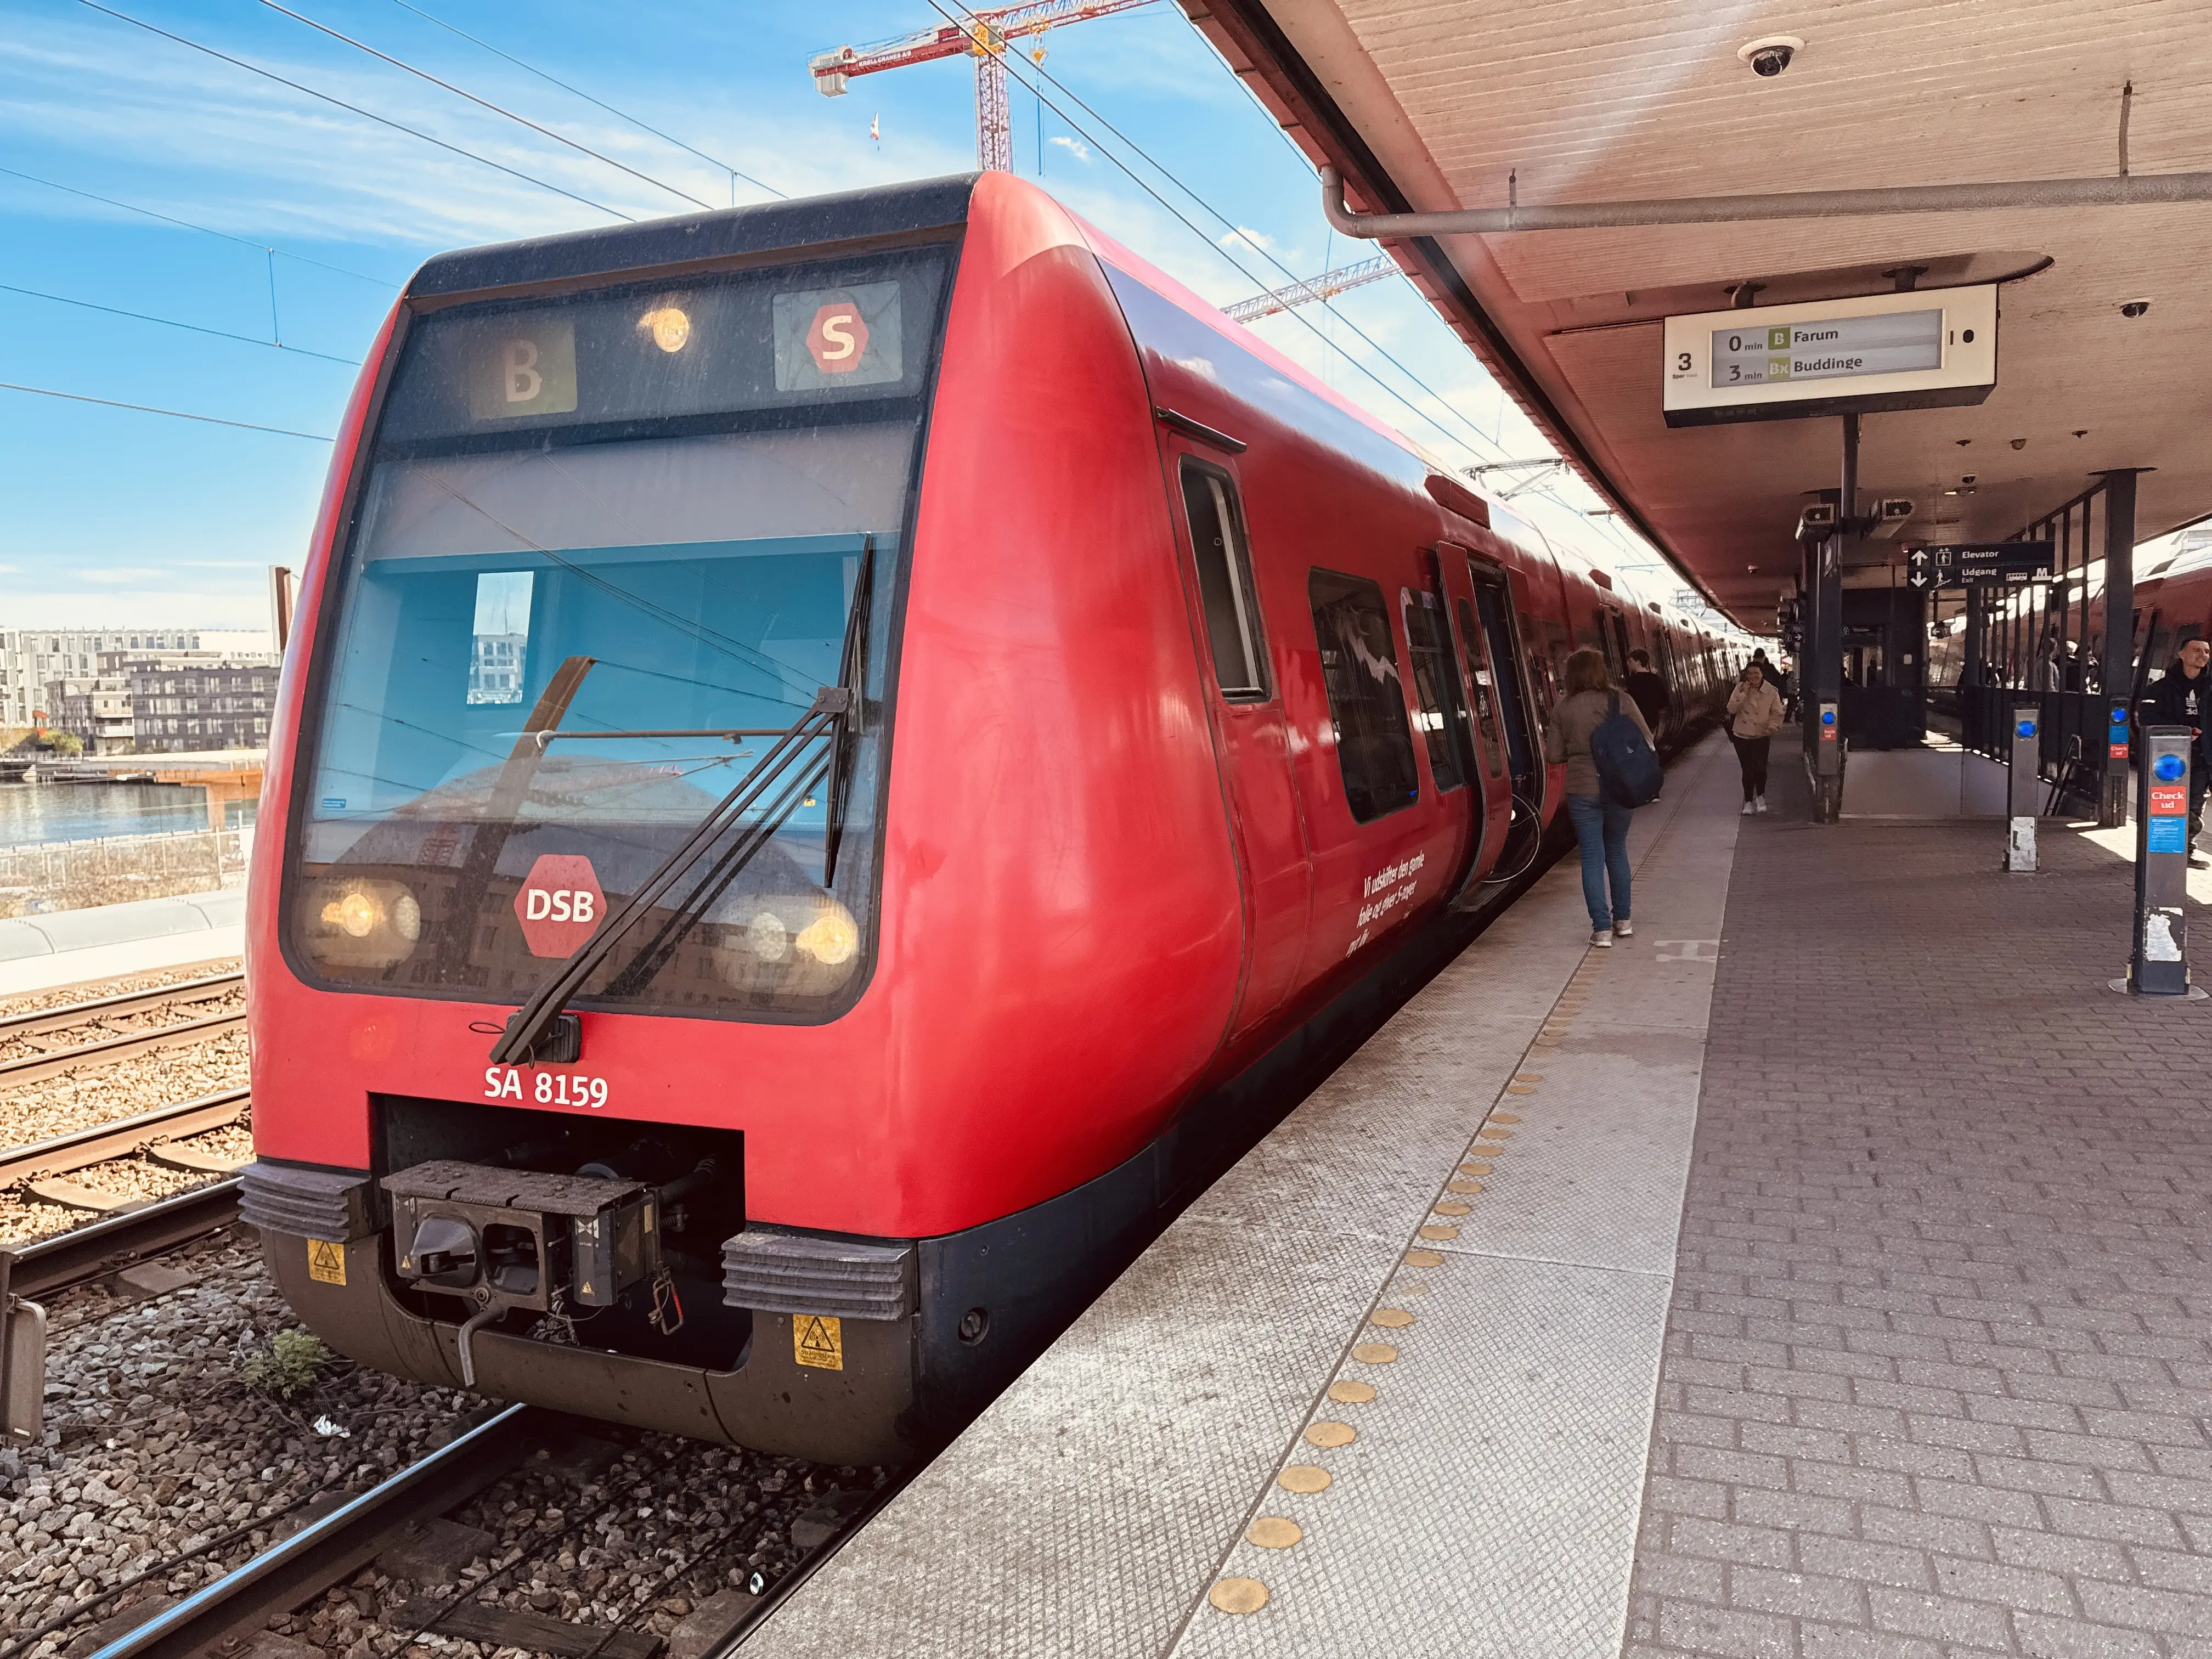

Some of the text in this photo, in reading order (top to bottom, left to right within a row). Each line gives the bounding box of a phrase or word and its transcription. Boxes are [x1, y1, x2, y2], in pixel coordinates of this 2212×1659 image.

[822, 314, 855, 360] S
[1729, 330, 1838, 352] 0 min B Farum
[503, 338, 540, 403] B
[1678, 353, 1692, 371] 3
[1729, 358, 1863, 381] 3 min Bx Buddinge
[1962, 568, 1997, 577] Udgang
[2152, 792, 2184, 800] Check
[1364, 849, 1425, 899] Vi udskifter den gamle
[526, 889, 594, 922] DSB
[484, 1066, 608, 1109] SA 8159
